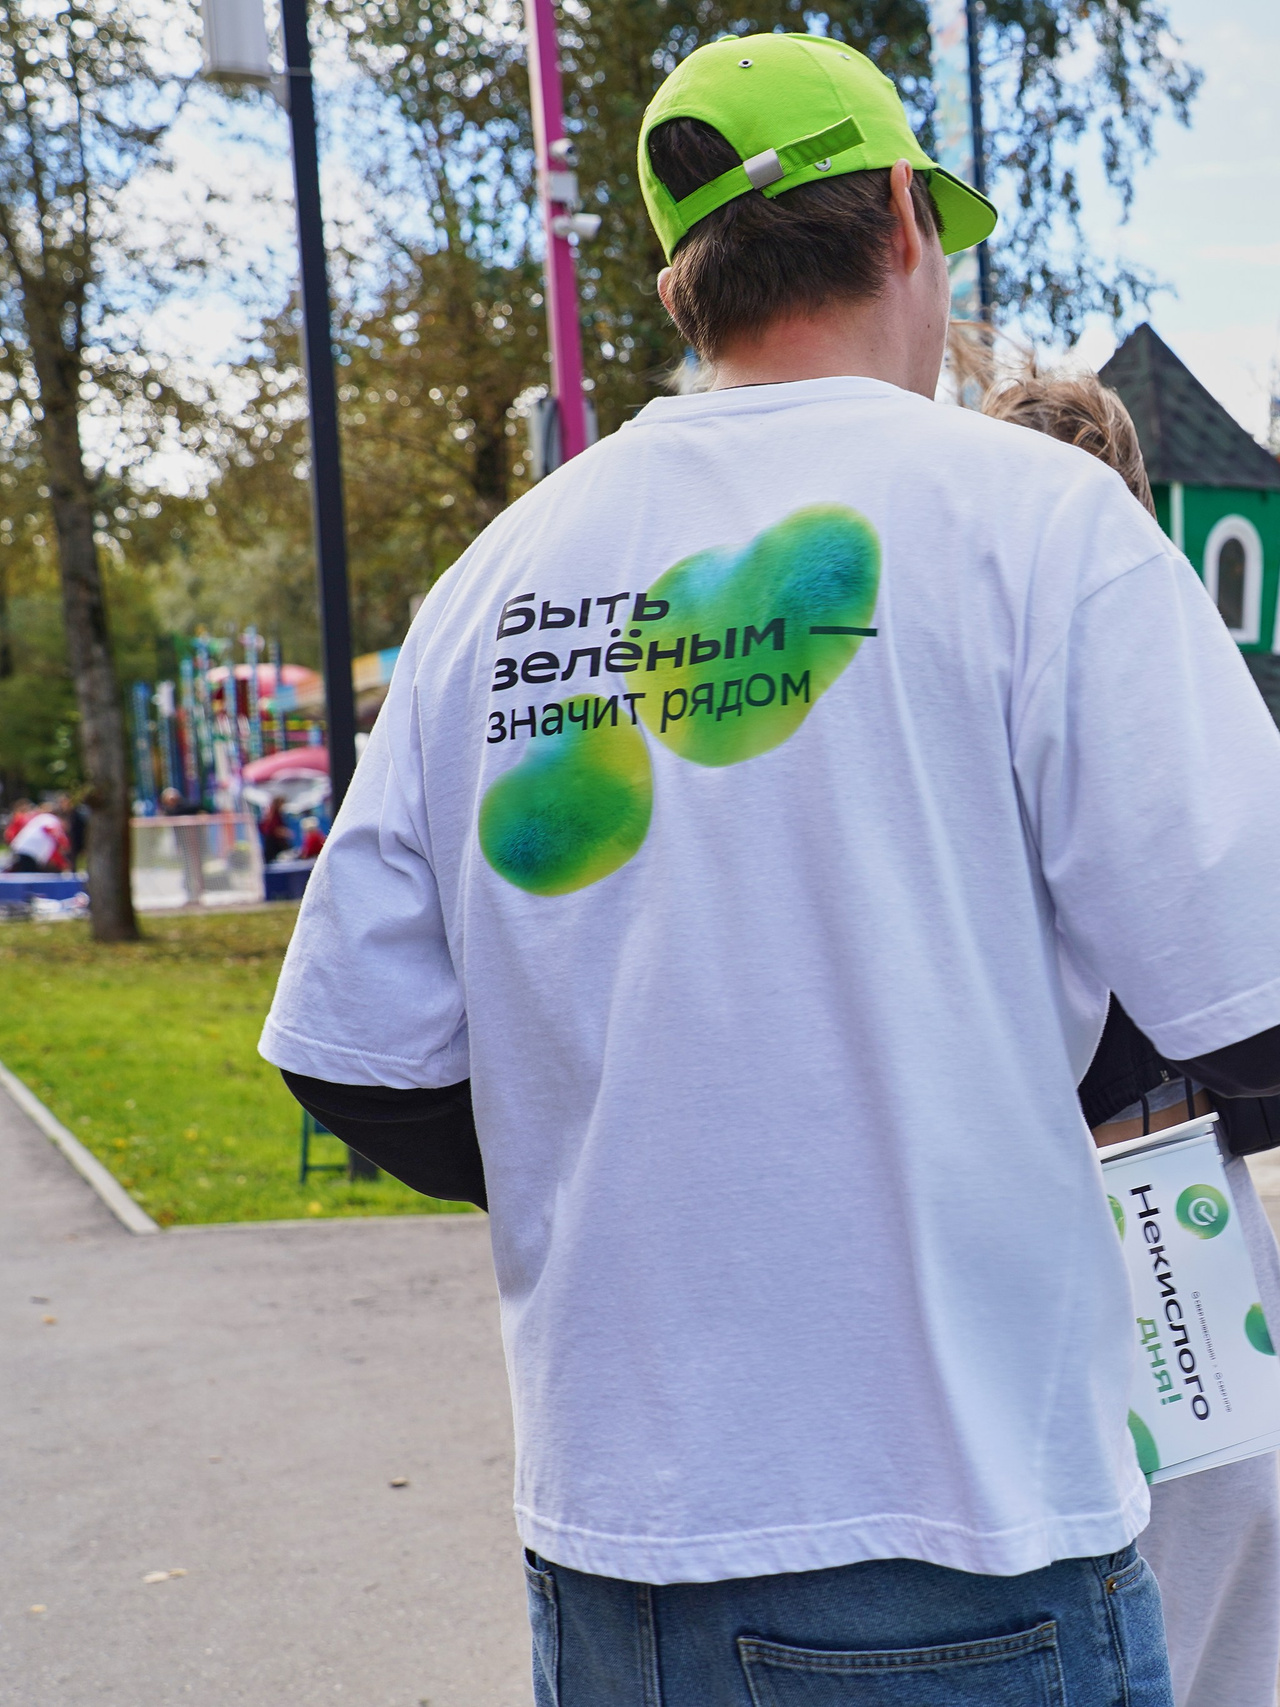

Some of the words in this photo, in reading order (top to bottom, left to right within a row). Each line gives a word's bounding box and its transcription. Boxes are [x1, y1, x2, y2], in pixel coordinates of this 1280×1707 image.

[496, 591, 670, 641] Быть
[491, 617, 786, 691] зелёным
[486, 692, 646, 743] значит
[659, 670, 811, 733] рядом
[1129, 1183, 1212, 1421] Некислого
[1136, 1316, 1184, 1406] дня!
